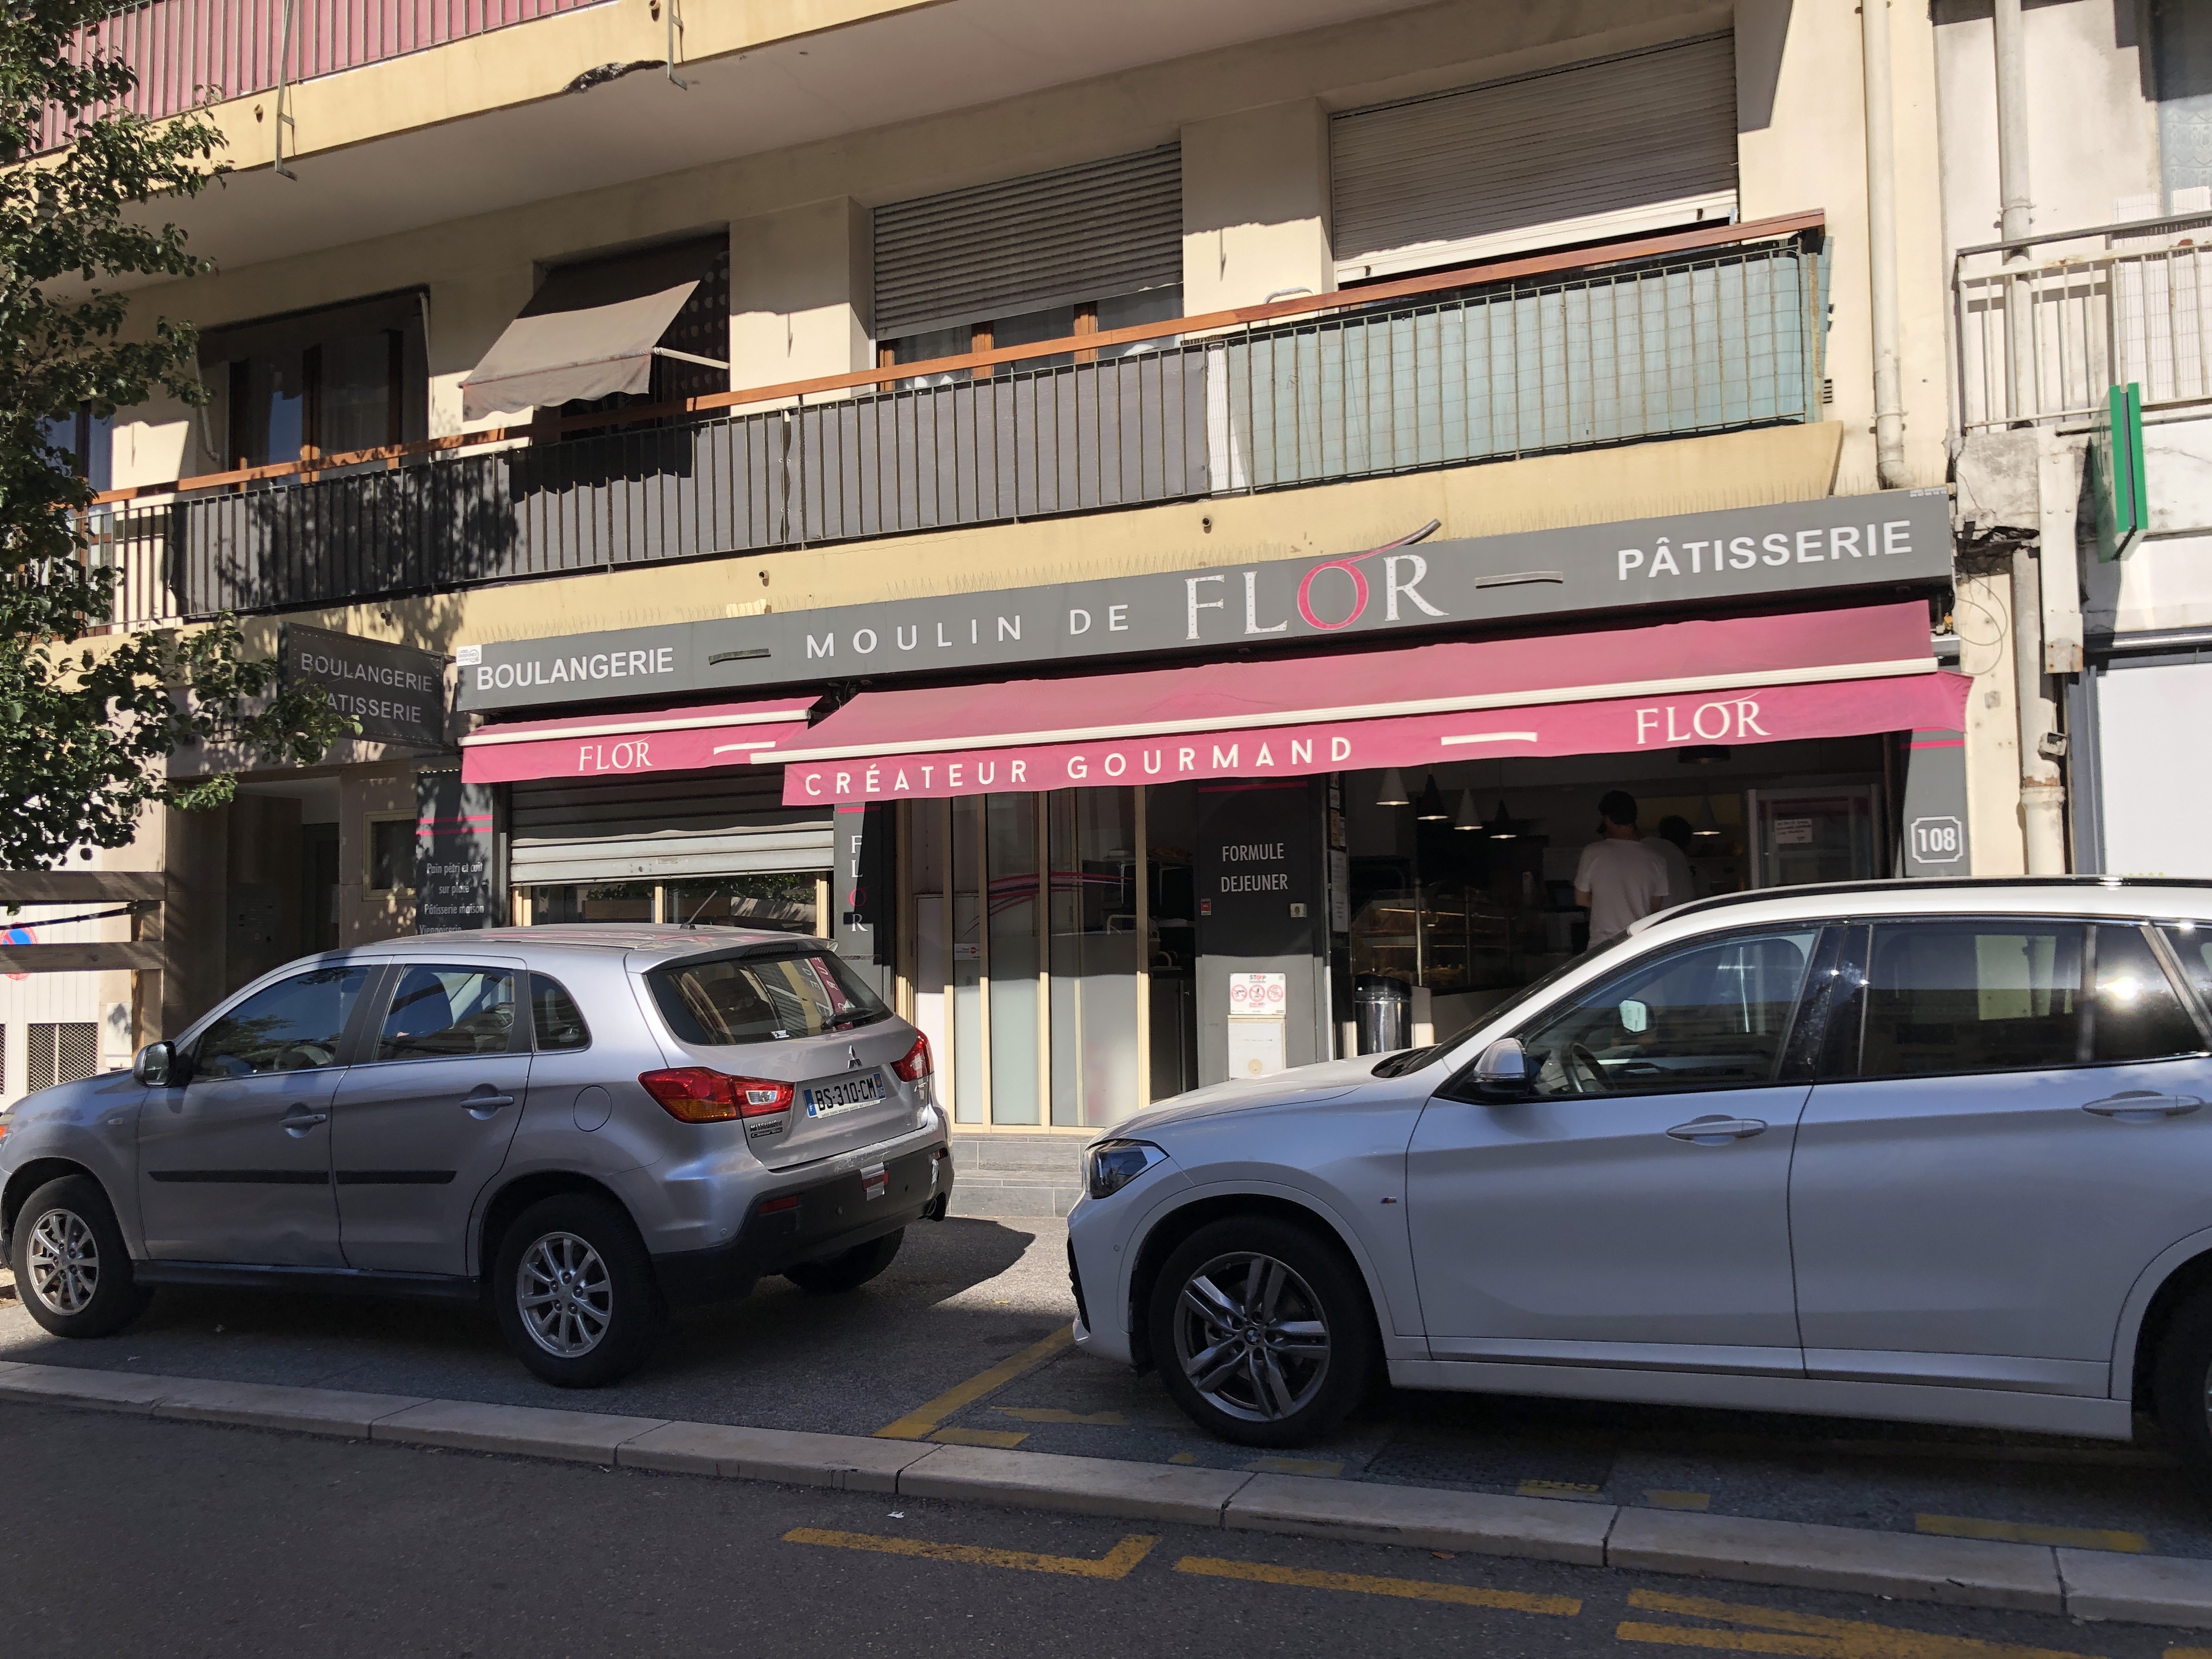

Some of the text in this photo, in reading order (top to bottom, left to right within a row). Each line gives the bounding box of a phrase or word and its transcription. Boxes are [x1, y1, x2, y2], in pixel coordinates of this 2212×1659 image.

[1617, 520, 1912, 581] PÂTISSERIE
[806, 518, 1450, 659] MOULIN DE FLOR
[301, 652, 433, 692] BOULANGERIE
[476, 647, 675, 691] BOULANGERIE
[327, 693, 421, 723] ATISSERIE
[1635, 691, 1773, 745] FLOR
[578, 735, 654, 771] FLOR
[805, 737, 1352, 796] CRÉATEUR GOURMAND
[1222, 843, 1285, 862] FORMULE
[1917, 827, 1956, 853] 108
[427, 863, 442, 874] Pain
[444, 862, 460, 876] pétri
[461, 863, 469, 872] et
[848, 835, 869, 932] FLOR
[1221, 873, 1289, 893] DEJEUNER
[439, 882, 470, 896] sur place
[459, 904, 484, 914] maison
[814, 1077, 877, 1111] BS-310-CM
